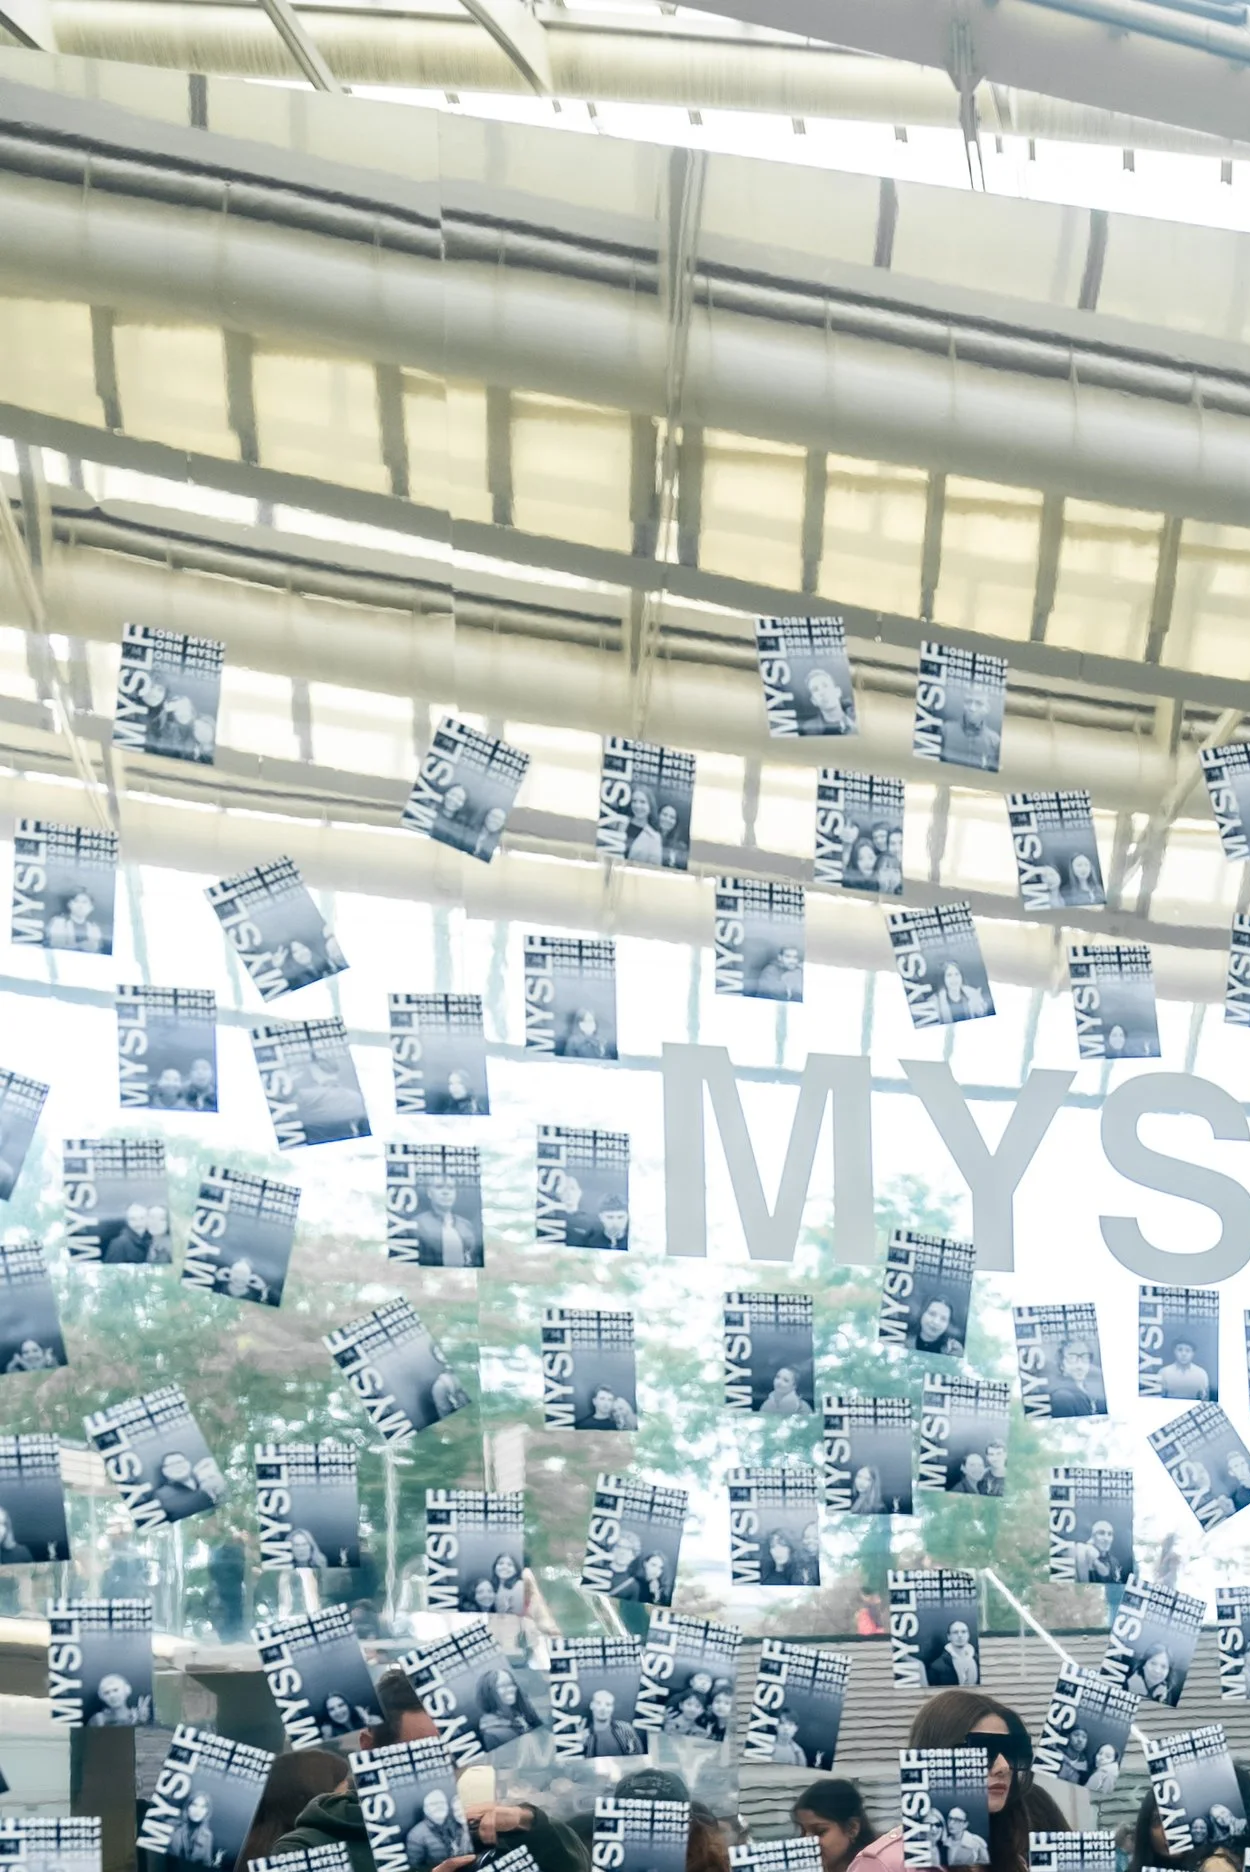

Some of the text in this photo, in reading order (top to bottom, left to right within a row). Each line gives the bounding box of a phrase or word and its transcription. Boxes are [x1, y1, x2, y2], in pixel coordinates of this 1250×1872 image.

[112, 622, 156, 753] MYSLF
[754, 617, 799, 737] MYSLF
[912, 641, 949, 762] MYSLF
[399, 714, 472, 837] MYSLF
[596, 735, 635, 860] MYSLF
[814, 766, 845, 888] MYSLF
[10, 817, 48, 950] MYSLF
[1005, 793, 1052, 911] MYSLF
[522, 933, 555, 1057] MYSLF
[715, 876, 744, 999] MYSLF
[884, 910, 942, 1031] MYSLF
[536, 1124, 567, 1248] MYSLF
[878, 1228, 918, 1349] MYSLF
[322, 1324, 418, 1448] MYSLF
[541, 1309, 575, 1431] MYSLF
[721, 1292, 752, 1413] MYSLF
[255, 1444, 294, 1570] MYSLF
[821, 1396, 851, 1515] MYSLF
[427, 1490, 458, 1614] MYSLF
[580, 1473, 628, 1598] MYSLF
[728, 1468, 761, 1588] MYSLF
[46, 1599, 82, 1727] MYSLF
[250, 1623, 323, 1751] MYSLF
[887, 1571, 922, 1689] MYSLF
[1213, 1587, 1247, 1701] MYSLF
[398, 1645, 487, 1768] MYSLF
[546, 1638, 584, 1762] MYSLF
[744, 1639, 792, 1762] MYSLF
[134, 1724, 207, 1854] MYSLF
[900, 1750, 932, 1868] MYSLF
[1141, 1738, 1195, 1855] MYSLF
